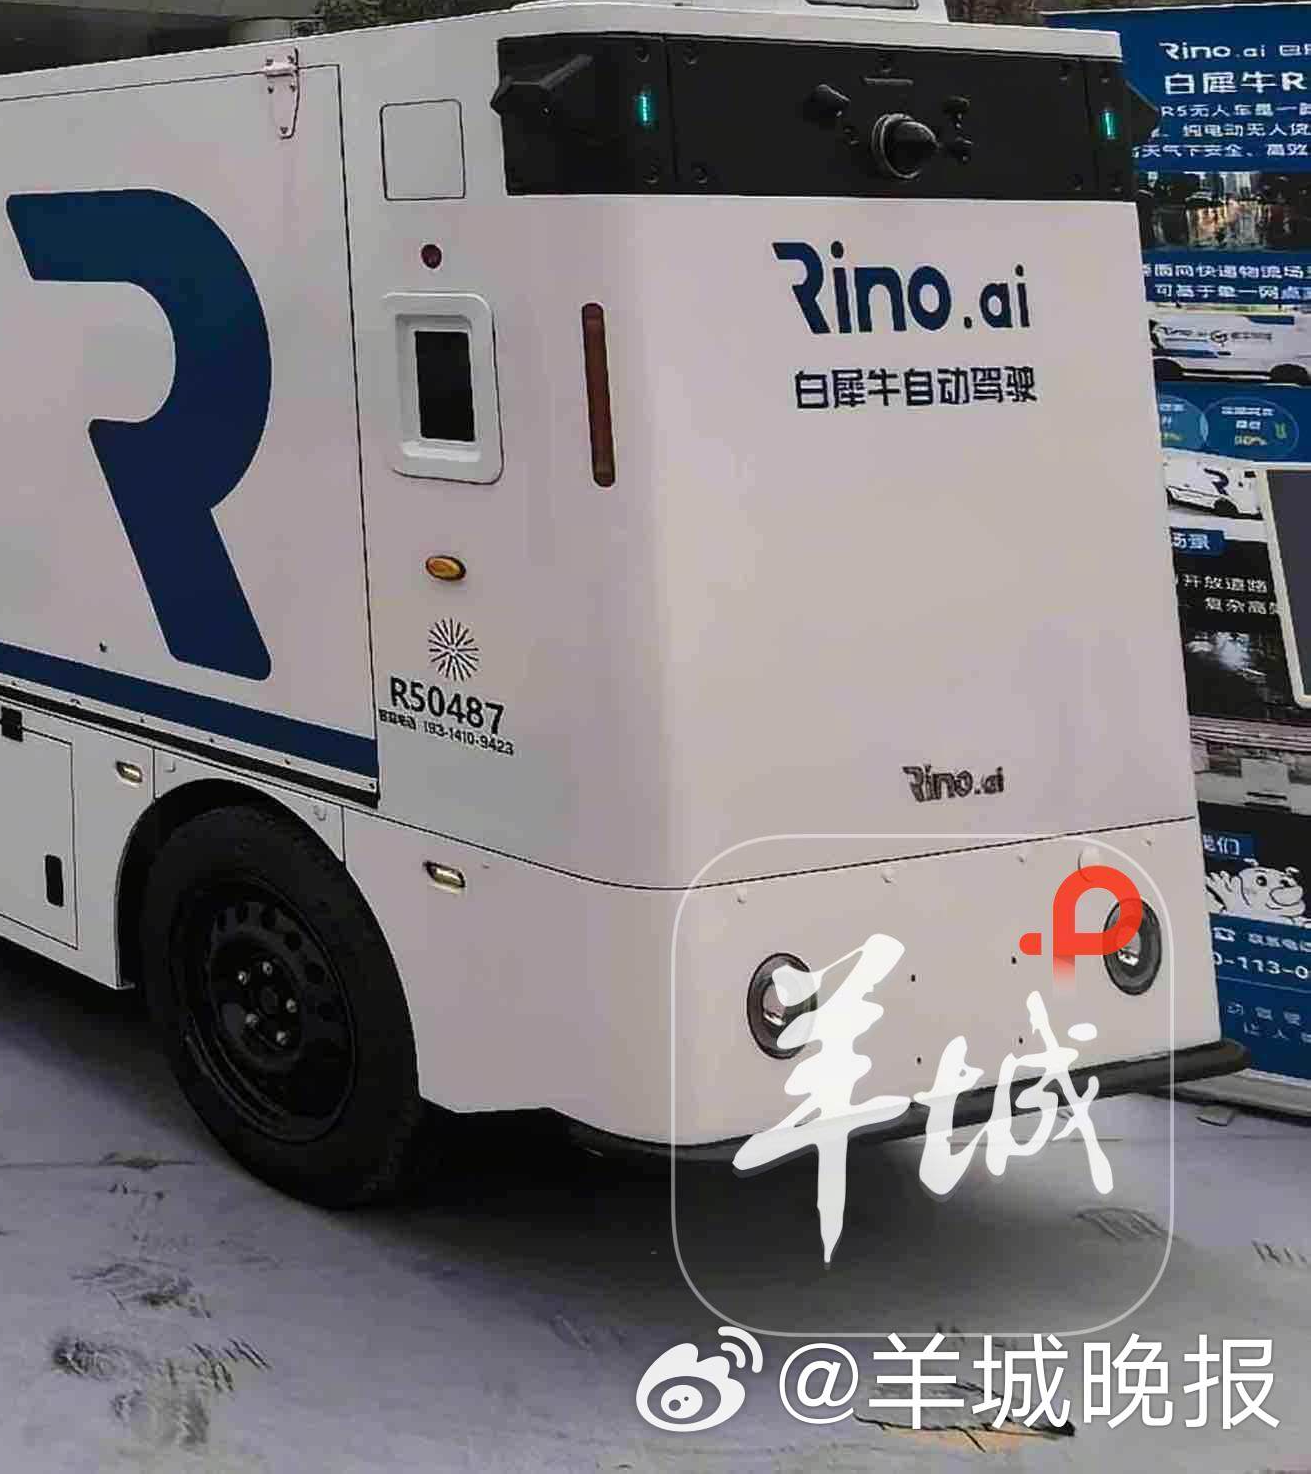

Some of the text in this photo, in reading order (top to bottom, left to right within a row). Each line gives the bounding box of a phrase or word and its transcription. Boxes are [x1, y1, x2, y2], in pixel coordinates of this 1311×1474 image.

[772, 240, 1031, 335] Rino.ai
[794, 365, 1038, 410] 白犀牛自动驾驶
[389, 675, 505, 735] R50487
